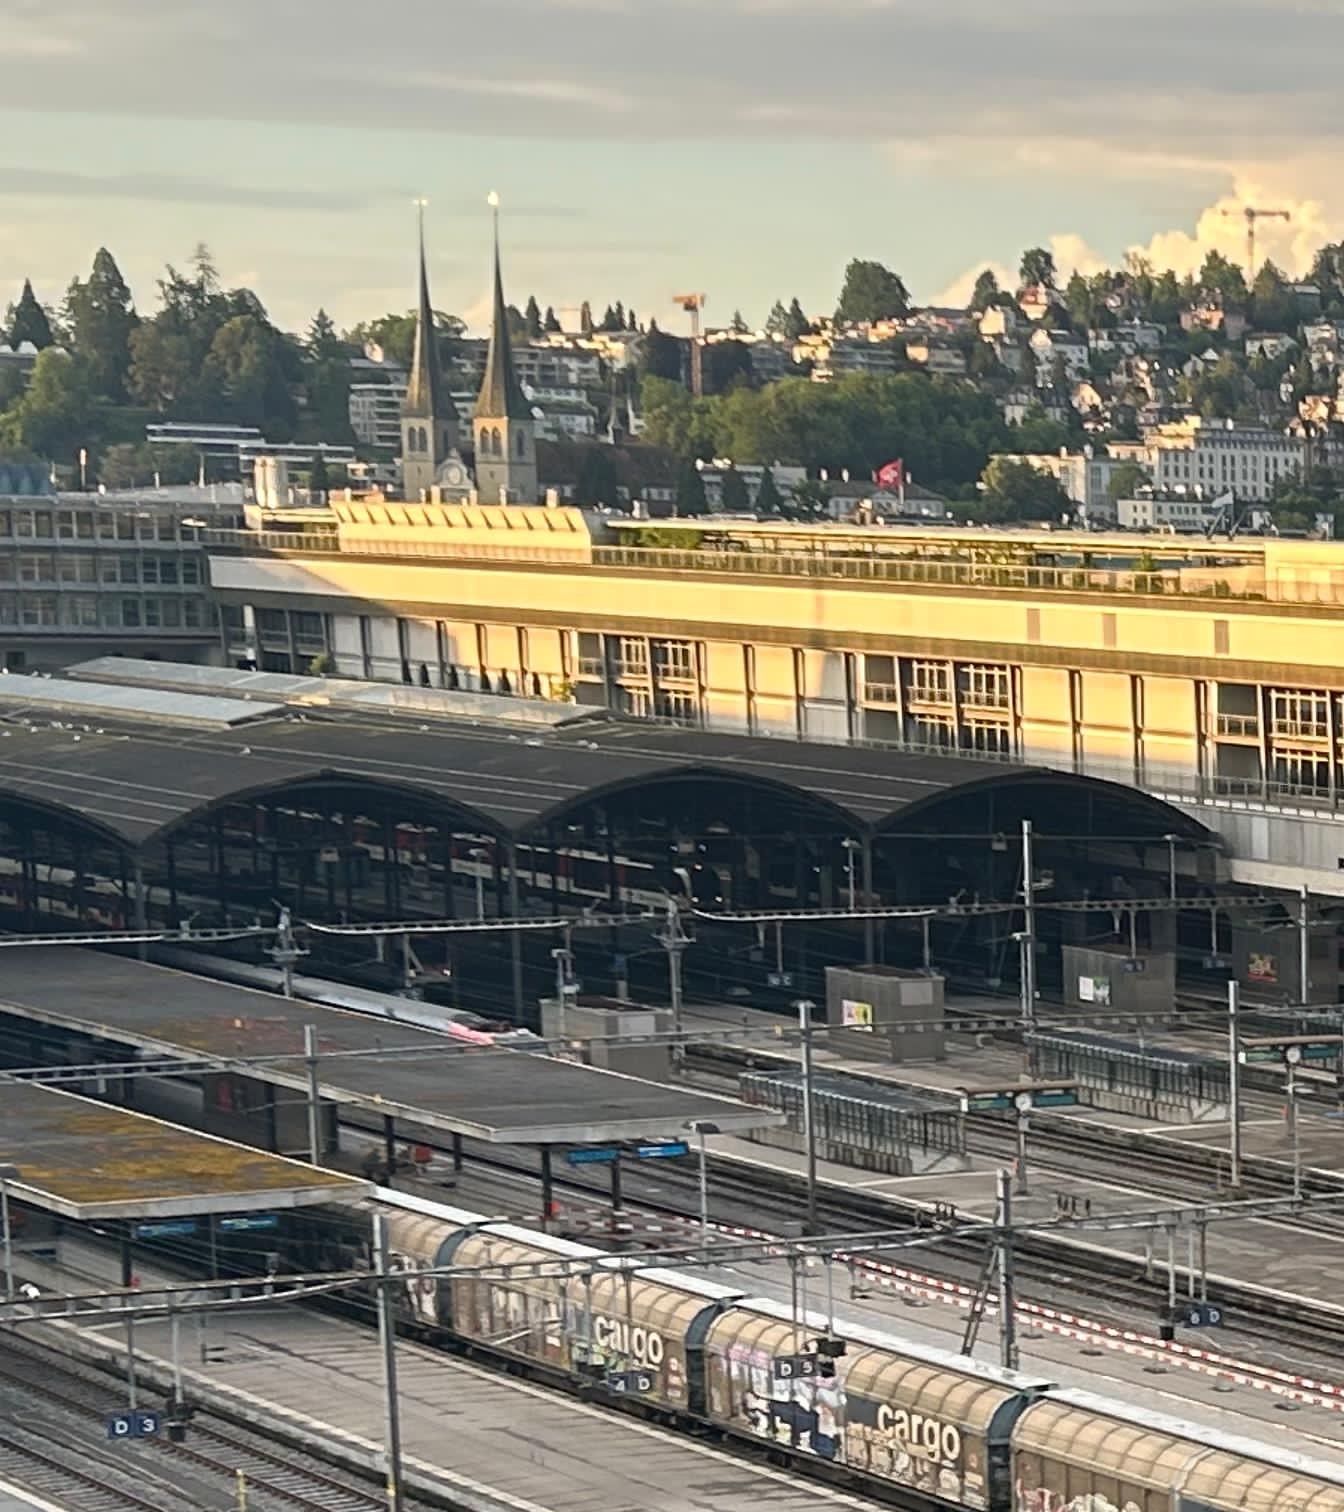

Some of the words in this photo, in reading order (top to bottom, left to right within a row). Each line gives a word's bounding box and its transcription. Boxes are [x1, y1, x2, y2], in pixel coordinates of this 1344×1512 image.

[115, 1420, 128, 1434] D
[143, 1418, 155, 1432] 3
[877, 1404, 960, 1463] cargo
